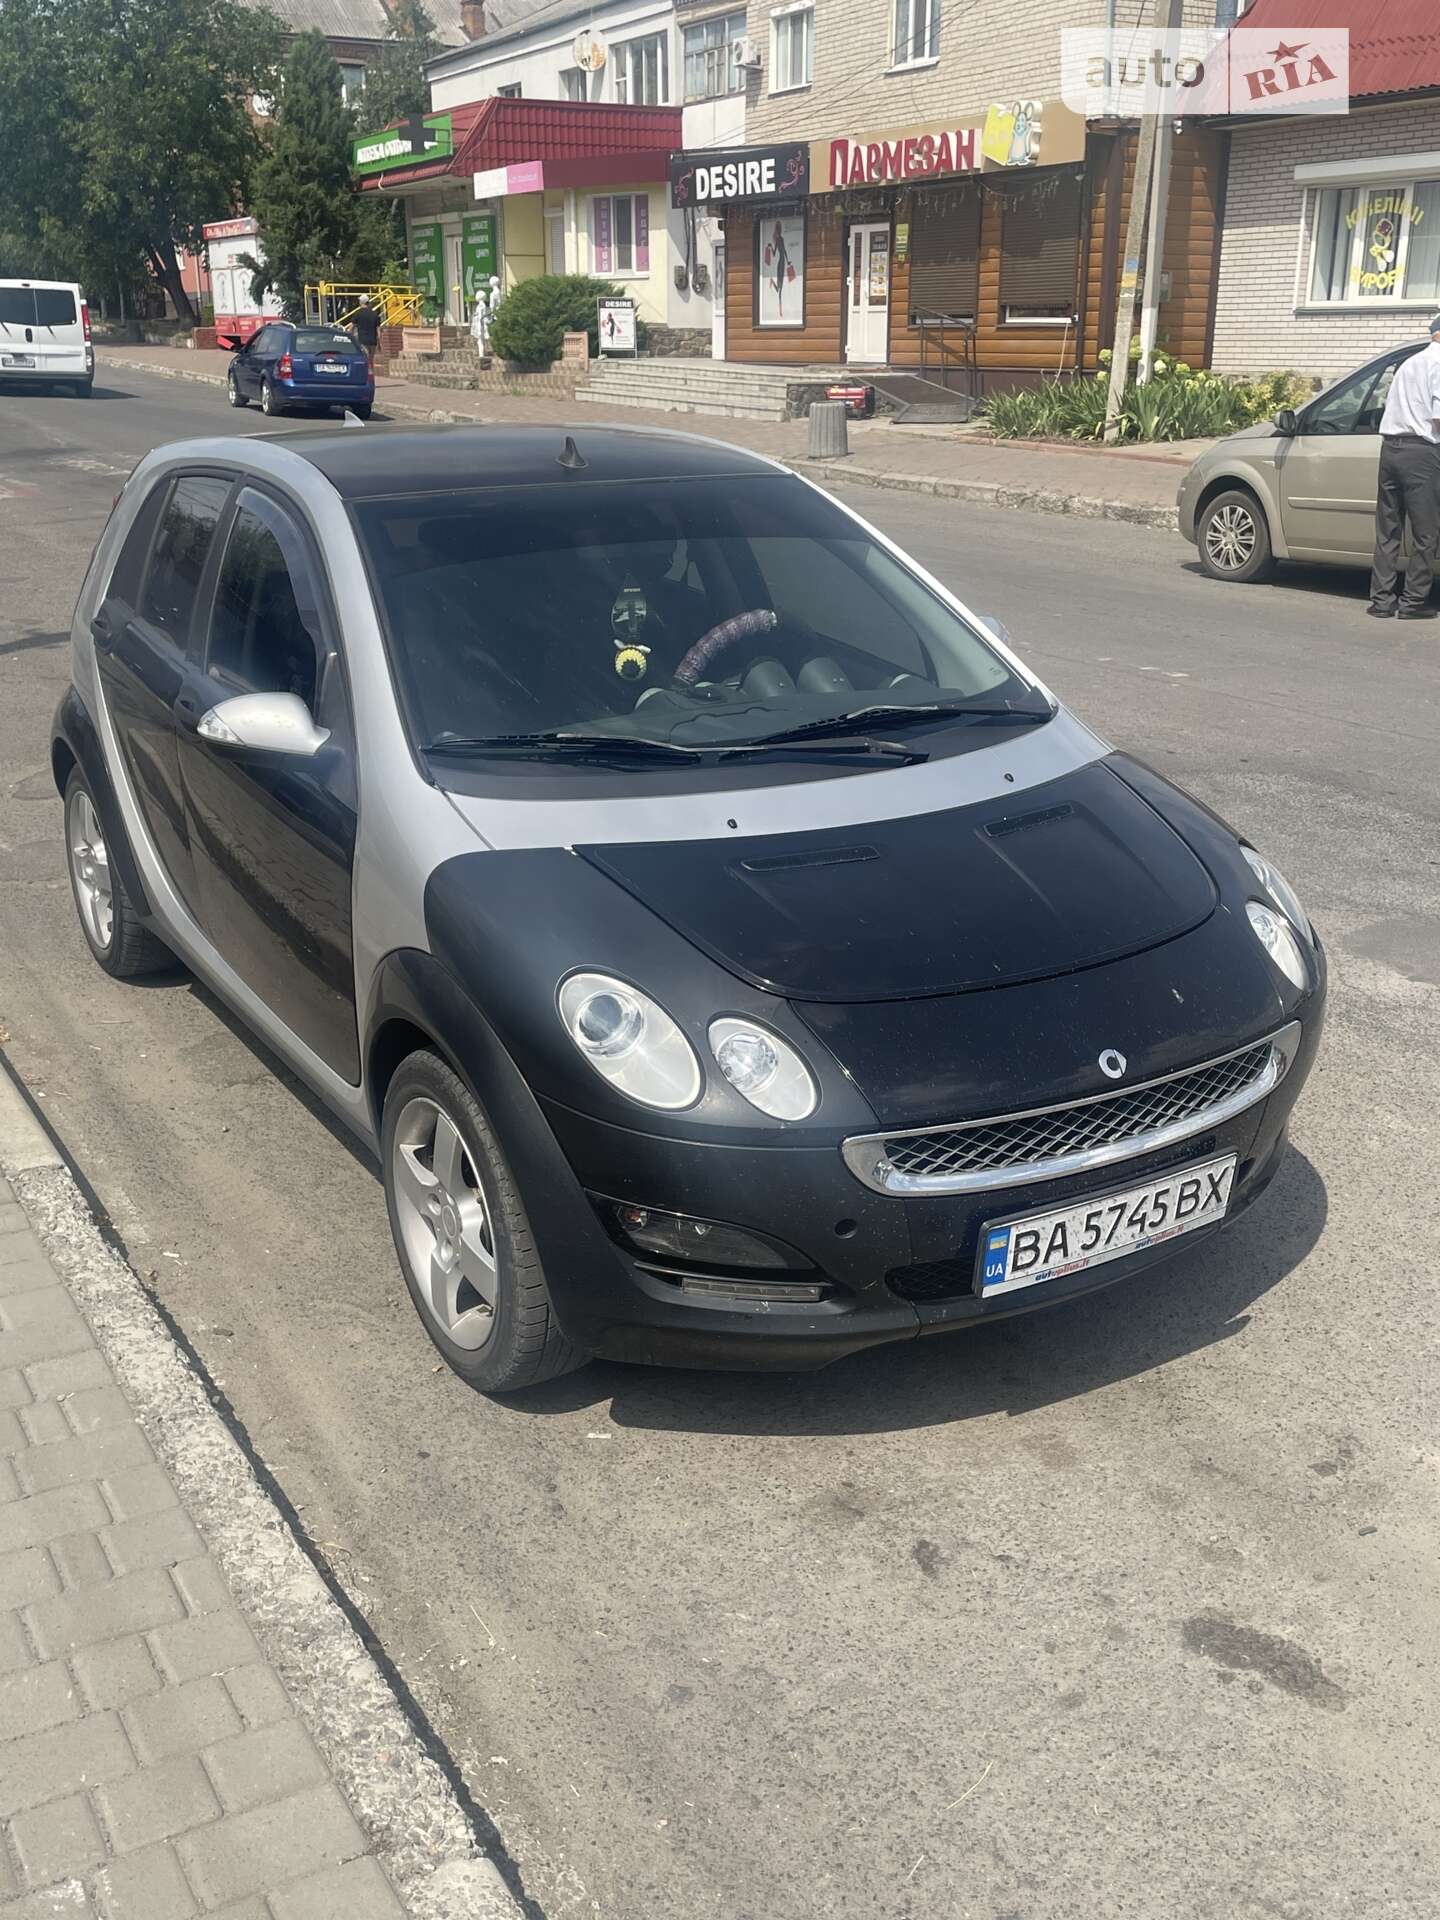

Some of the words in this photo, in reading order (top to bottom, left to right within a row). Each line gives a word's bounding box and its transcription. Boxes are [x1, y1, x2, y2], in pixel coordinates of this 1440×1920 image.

[695, 158, 776, 201] DESIRE
[829, 128, 976, 187] ПАРМЕЗАН
[1011, 1221, 1069, 1273] BA
[986, 1264, 1004, 1278] UA
